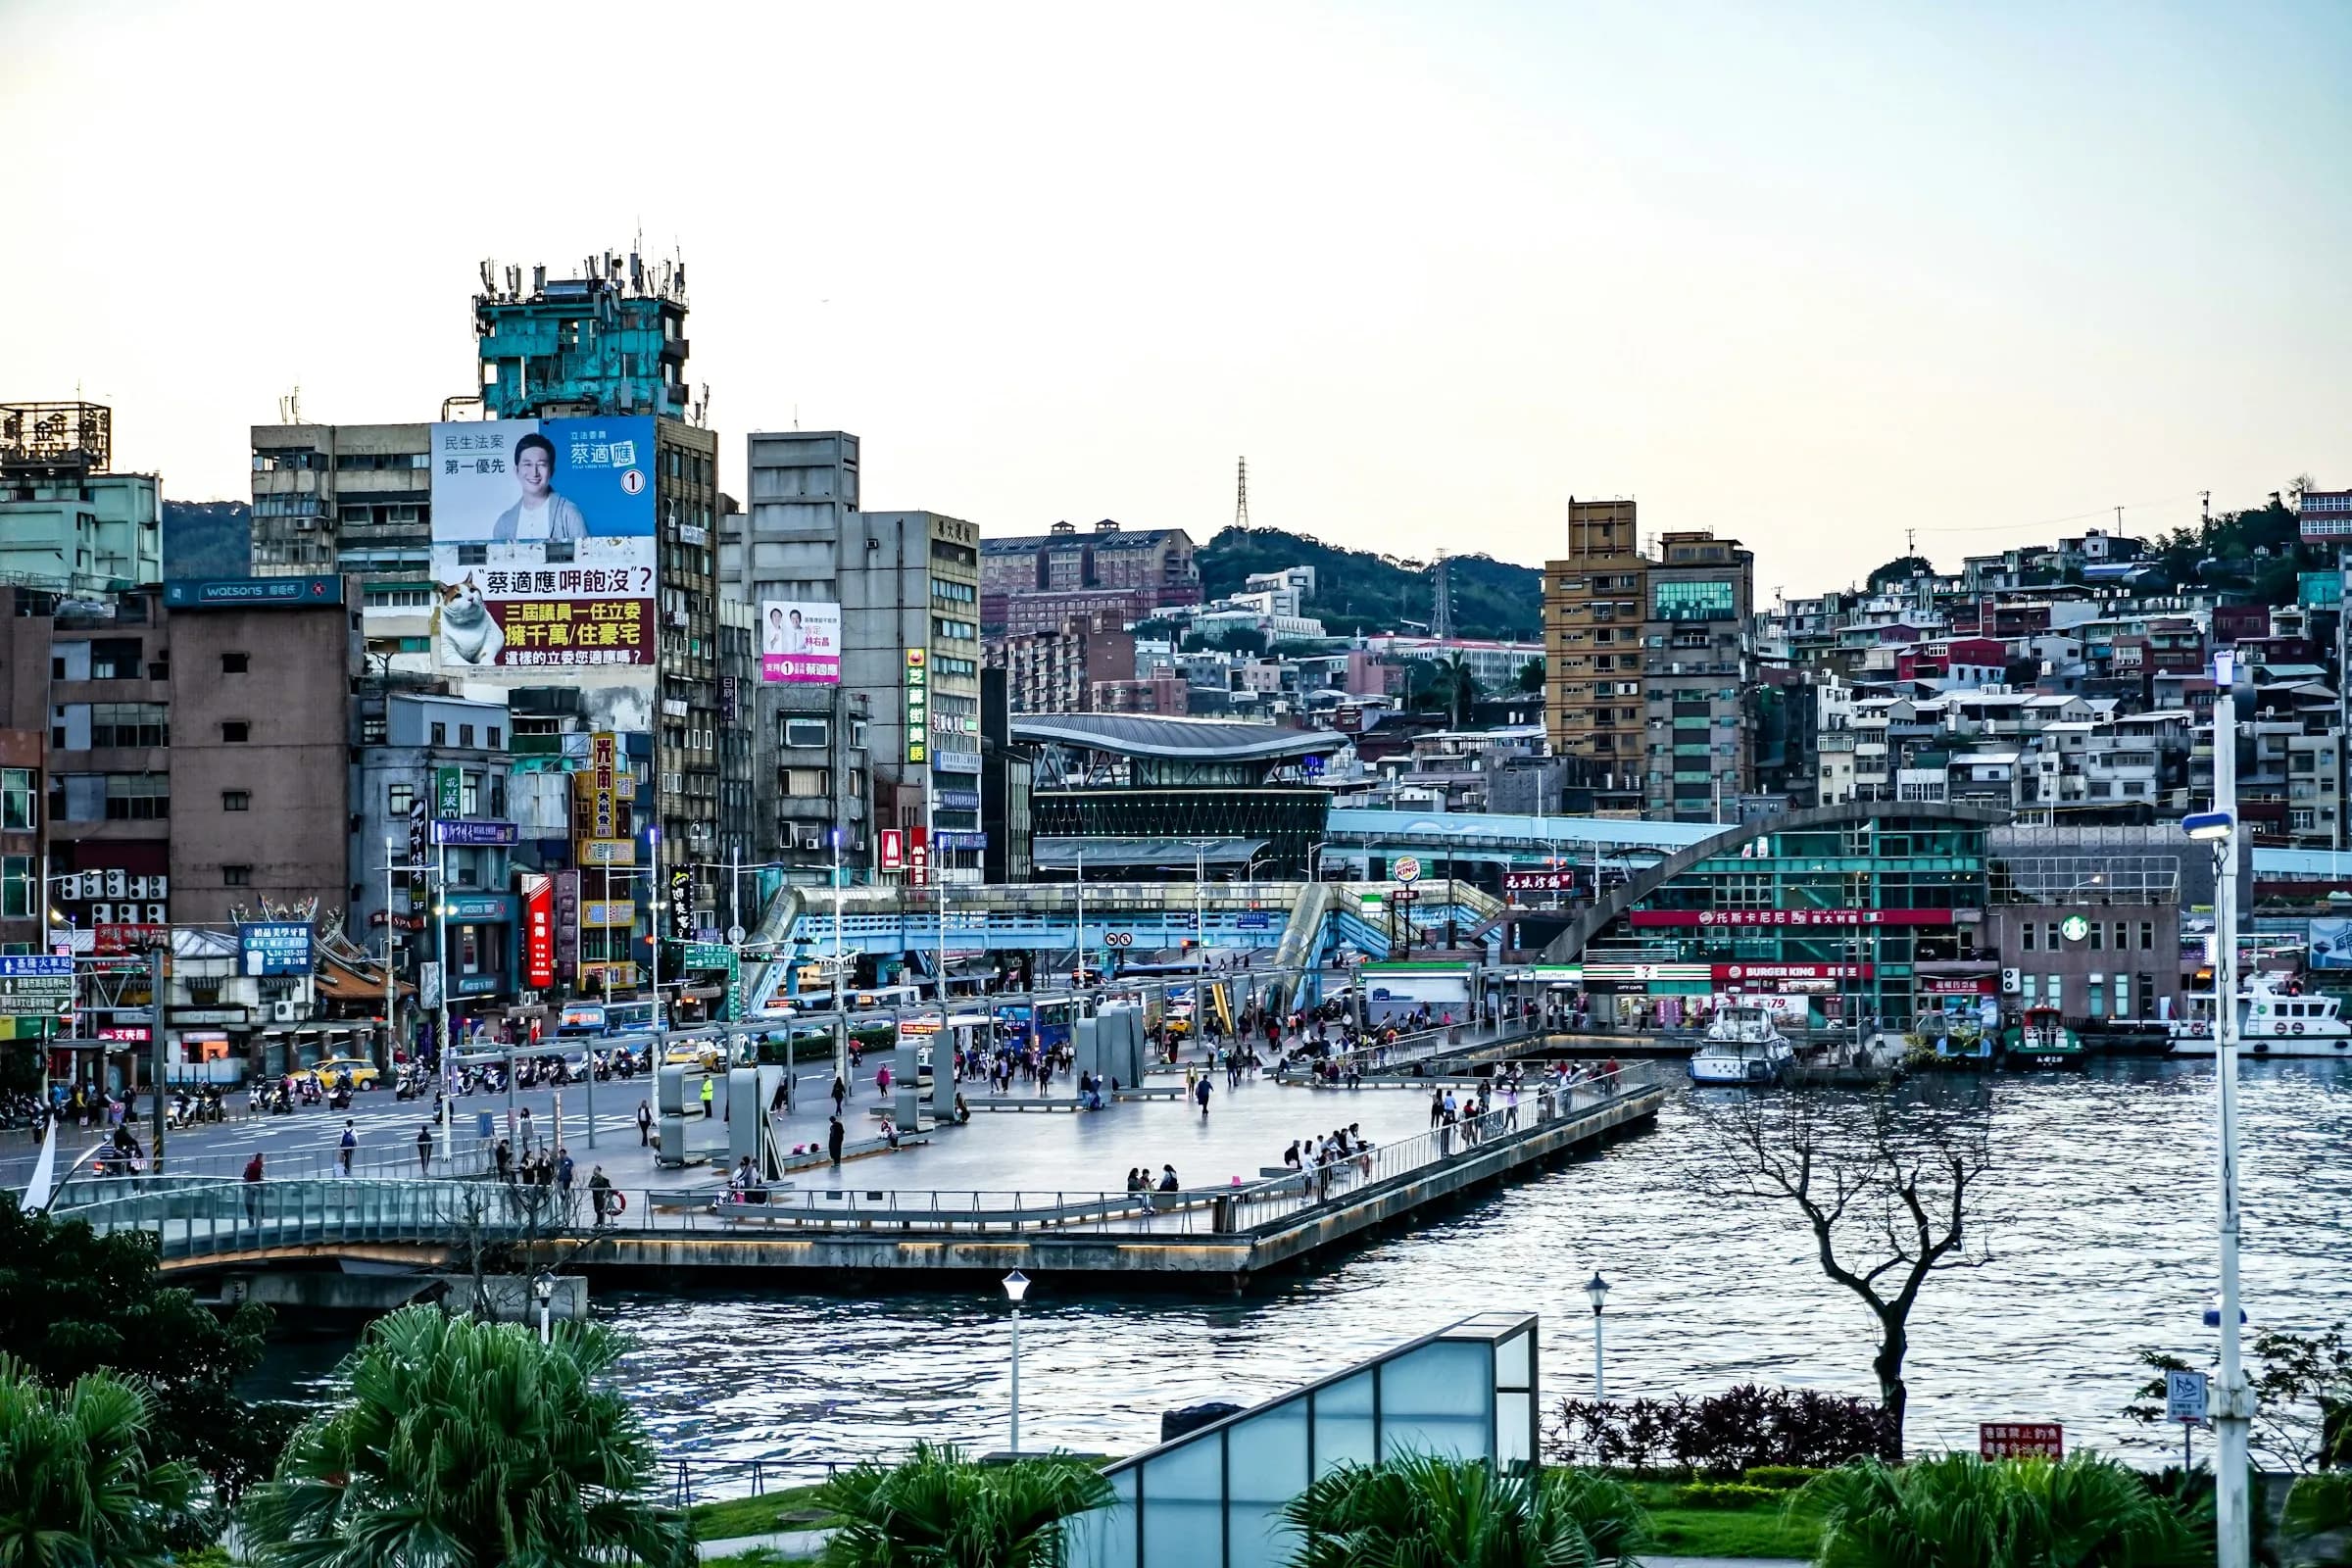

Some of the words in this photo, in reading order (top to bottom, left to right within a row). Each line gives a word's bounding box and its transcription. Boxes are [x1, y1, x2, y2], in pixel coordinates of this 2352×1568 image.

[445, 434, 505, 450] 民生法案
[570, 441, 634, 466] 蔡適應
[445, 459, 506, 474] 第一優先
[629, 473, 636, 490] 1
[207, 586, 263, 597] watsons
[505, 603, 641, 622] 三屆議員一任立委
[505, 623, 641, 647] 擁千萬/住豪宅
[805, 636, 830, 647] 林右昌
[765, 663, 780, 672] 支持
[908, 668, 924, 761] 芝麻街美語
[595, 738, 612, 825] 光南大批發
[441, 808, 459, 818] KTV
[1396, 860, 1416, 871] BURGER
[1397, 865, 1417, 878] KING
[413, 902, 424, 910] 3F
[1189, 913, 1197, 922] P
[1716, 911, 1786, 924] 托斯卡尼尼
[17, 956, 71, 968] 基隆火車站
[1746, 967, 1788, 977] BURGER
[1788, 967, 1815, 977] KING
[1771, 998, 1786, 1007] 79
[1984, 1427, 2058, 1440] 港區禁止釣魚
